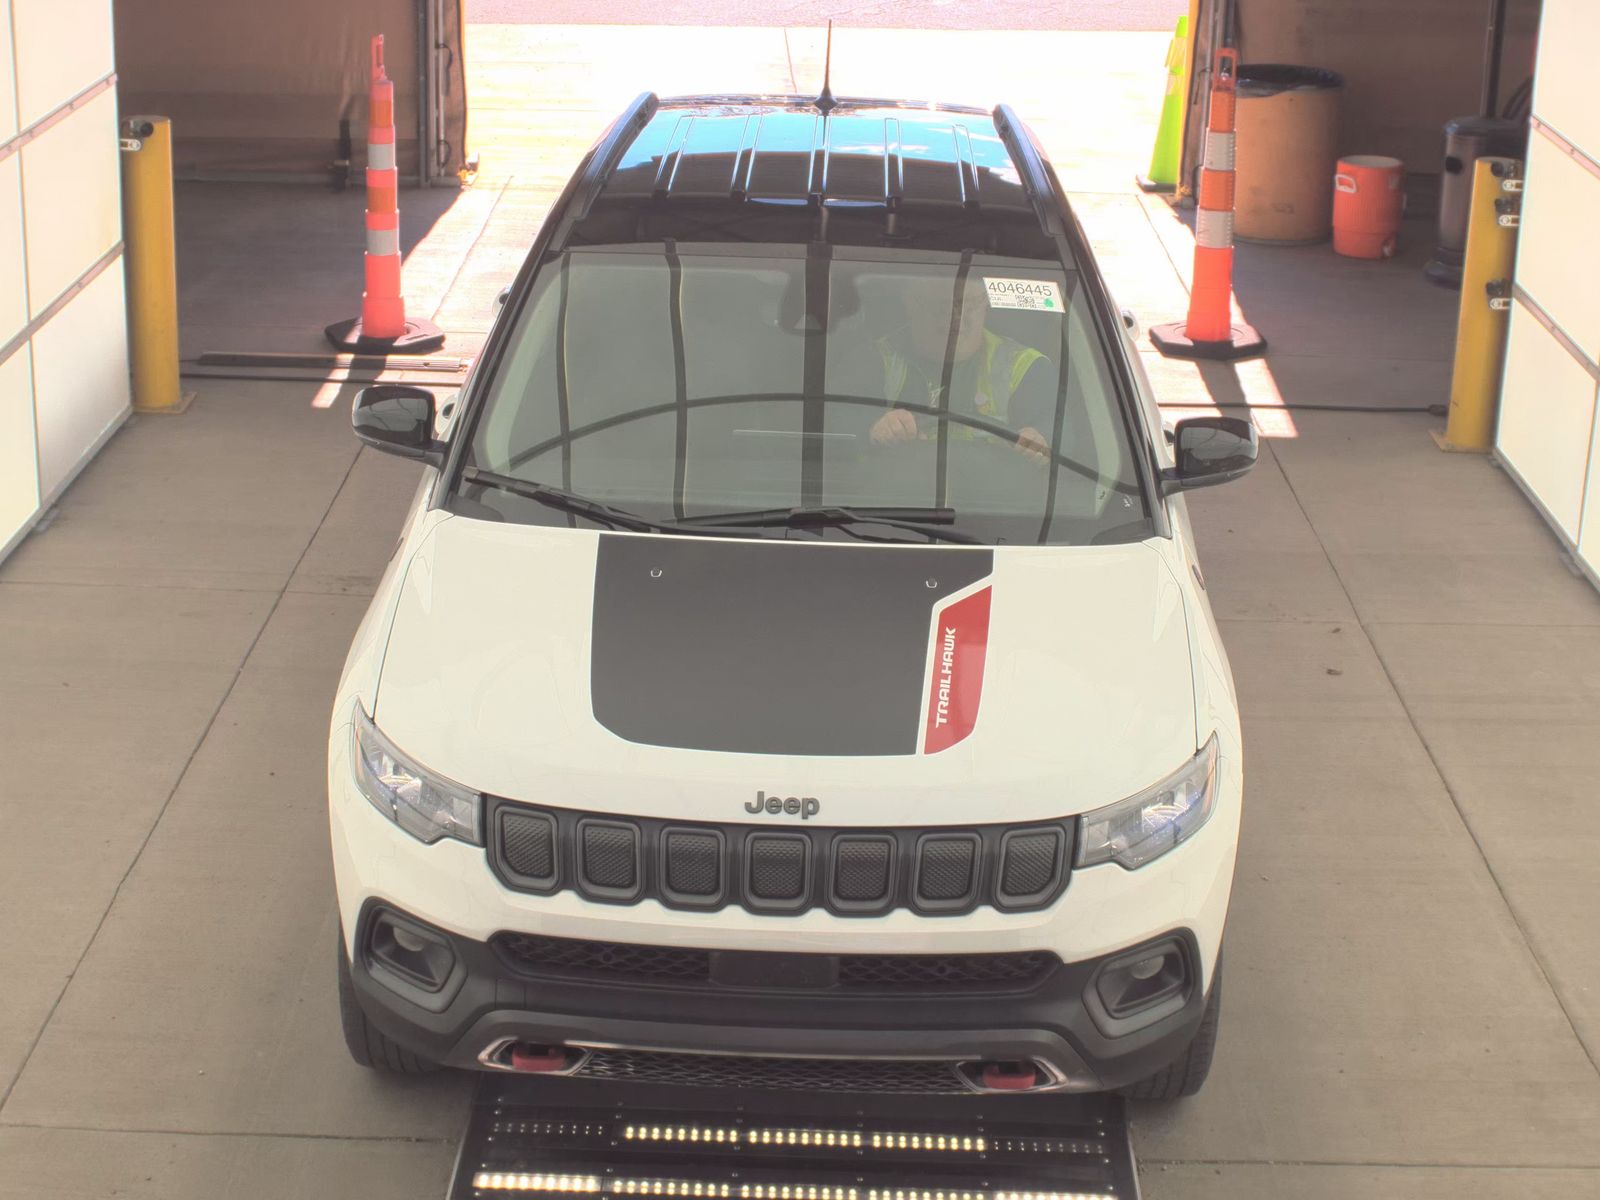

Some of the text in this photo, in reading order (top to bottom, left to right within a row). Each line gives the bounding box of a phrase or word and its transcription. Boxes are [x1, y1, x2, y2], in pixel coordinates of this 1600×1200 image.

[988, 281, 1052, 297] 4046445
[935, 626, 957, 729] TRAILHAWK
[744, 790, 820, 820] Jeep
